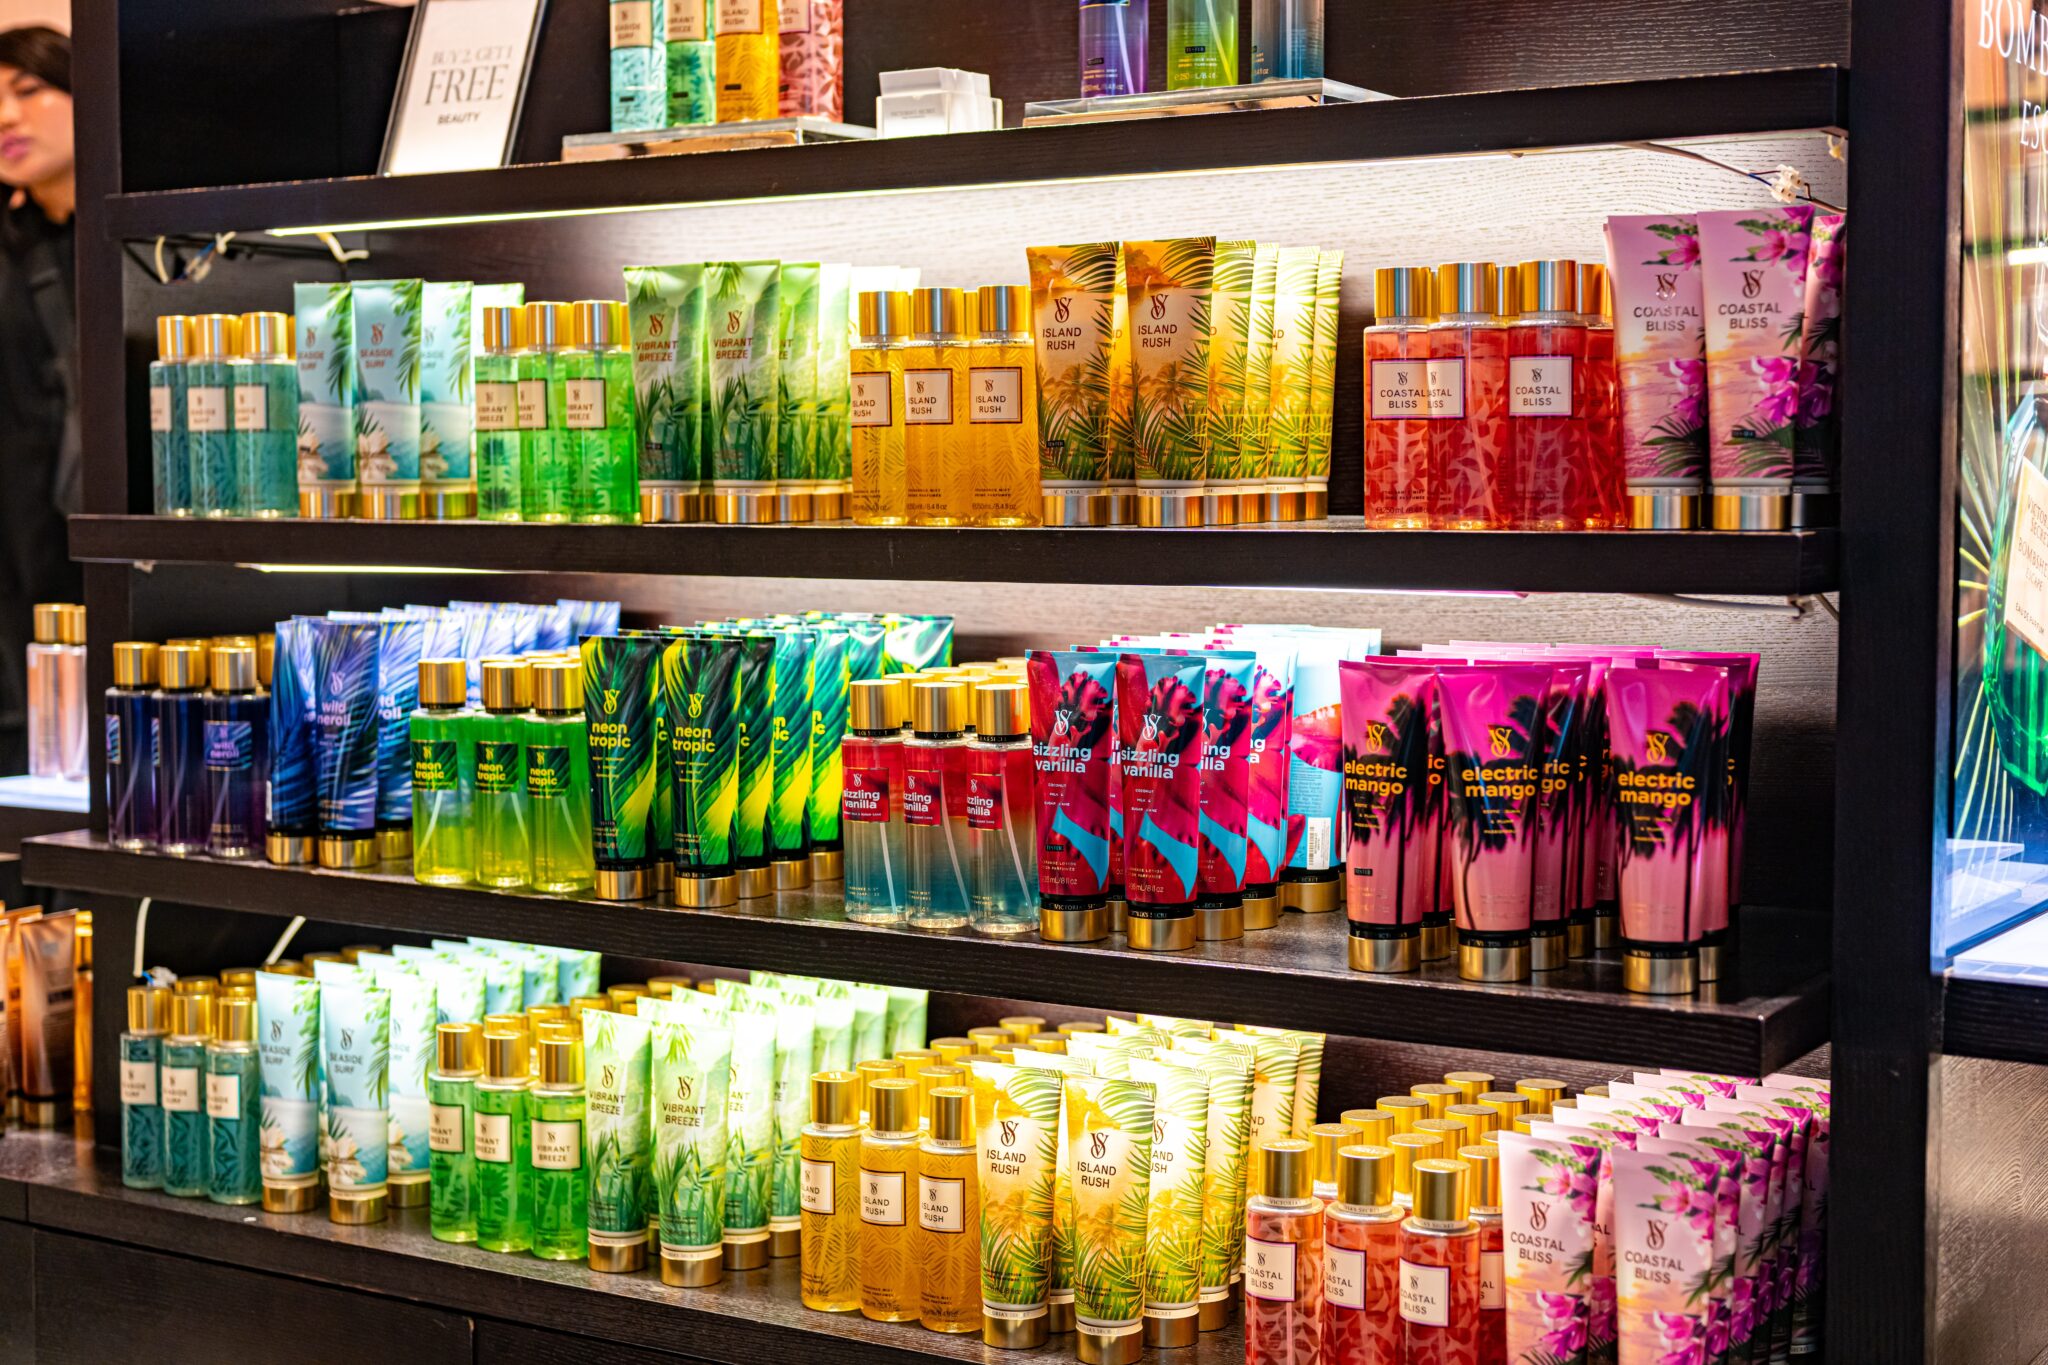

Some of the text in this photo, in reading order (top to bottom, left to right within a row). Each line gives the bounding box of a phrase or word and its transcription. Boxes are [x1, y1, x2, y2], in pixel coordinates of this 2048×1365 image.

[424, 64, 509, 105] FREE
[437, 111, 480, 125] BEAUTY
[1633, 306, 1699, 318] COASTAL
[1718, 303, 1782, 315] COASTAL
[1646, 320, 1686, 332] BLISS
[1729, 317, 1768, 329] BLISS
[1042, 327, 1082, 338] ISLAND
[1137, 324, 1178, 335] ISLAND
[636, 340, 678, 350] VIBRANT
[713, 337, 753, 348] VIBRANT
[1046, 340, 1075, 350] RUSH
[1142, 337, 1171, 348] RUSH
[638, 351, 673, 362] BREEZE
[716, 349, 748, 360] BREEZE
[1380, 388, 1426, 398] COASTAL
[1515, 386, 1561, 395] COASTAL
[975, 395, 1006, 403] ISLAND
[1388, 400, 1418, 409] BLISS
[1523, 397, 1552, 406] BLISS
[911, 406, 932, 415] RUSH
[979, 405, 1001, 413] RUSH
[322, 701, 346, 712] wild
[317, 713, 351, 726] neroli
[592, 722, 628, 733] neon
[675, 725, 712, 739] neon
[589, 735, 631, 749] tropic
[672, 739, 715, 754] tropic
[1033, 743, 1092, 761] sizzling
[1200, 742, 1231, 759] ling
[1121, 749, 1180, 767] sizzling
[1201, 755, 1225, 771] illa
[416, 762, 442, 770] neon
[479, 763, 503, 772] neon
[1035, 759, 1086, 773] vanilla
[1123, 764, 1174, 779] vanilla
[1344, 760, 1408, 779] electric
[415, 770, 444, 780] tropic
[477, 771, 506, 781] tropic
[530, 768, 555, 777] neon
[1462, 764, 1538, 782] electric
[529, 776, 557, 786] tropic
[1618, 771, 1695, 789] electric
[1345, 779, 1404, 796] mango
[1465, 783, 1536, 800] mango
[1620, 790, 1692, 808] mango
[904, 802, 929, 813] anilla
[329, 1052, 363, 1065] SEASIDE
[334, 1065, 355, 1074] SURF
[589, 1090, 626, 1104] VIBRANT
[590, 1102, 621, 1116] BREEZE
[662, 1102, 705, 1115] VIBRANT
[665, 1115, 700, 1127] BREEZE
[986, 1149, 1027, 1163] ISLAND
[991, 1164, 1020, 1175] RUSH
[1077, 1161, 1117, 1176] ISLAND
[1151, 1162, 1168, 1174] USH
[1081, 1177, 1110, 1189] RUSH
[866, 1207, 886, 1216] RUSH
[924, 1212, 945, 1222] RUSH
[1510, 1231, 1566, 1252] COASTAL
[1518, 1247, 1553, 1265] BLISS
[1624, 1250, 1685, 1272] COASTAL
[1635, 1268, 1671, 1285] BLISS
[1251, 1280, 1275, 1290] BLISS
[1404, 1304, 1428, 1315] BLISS
